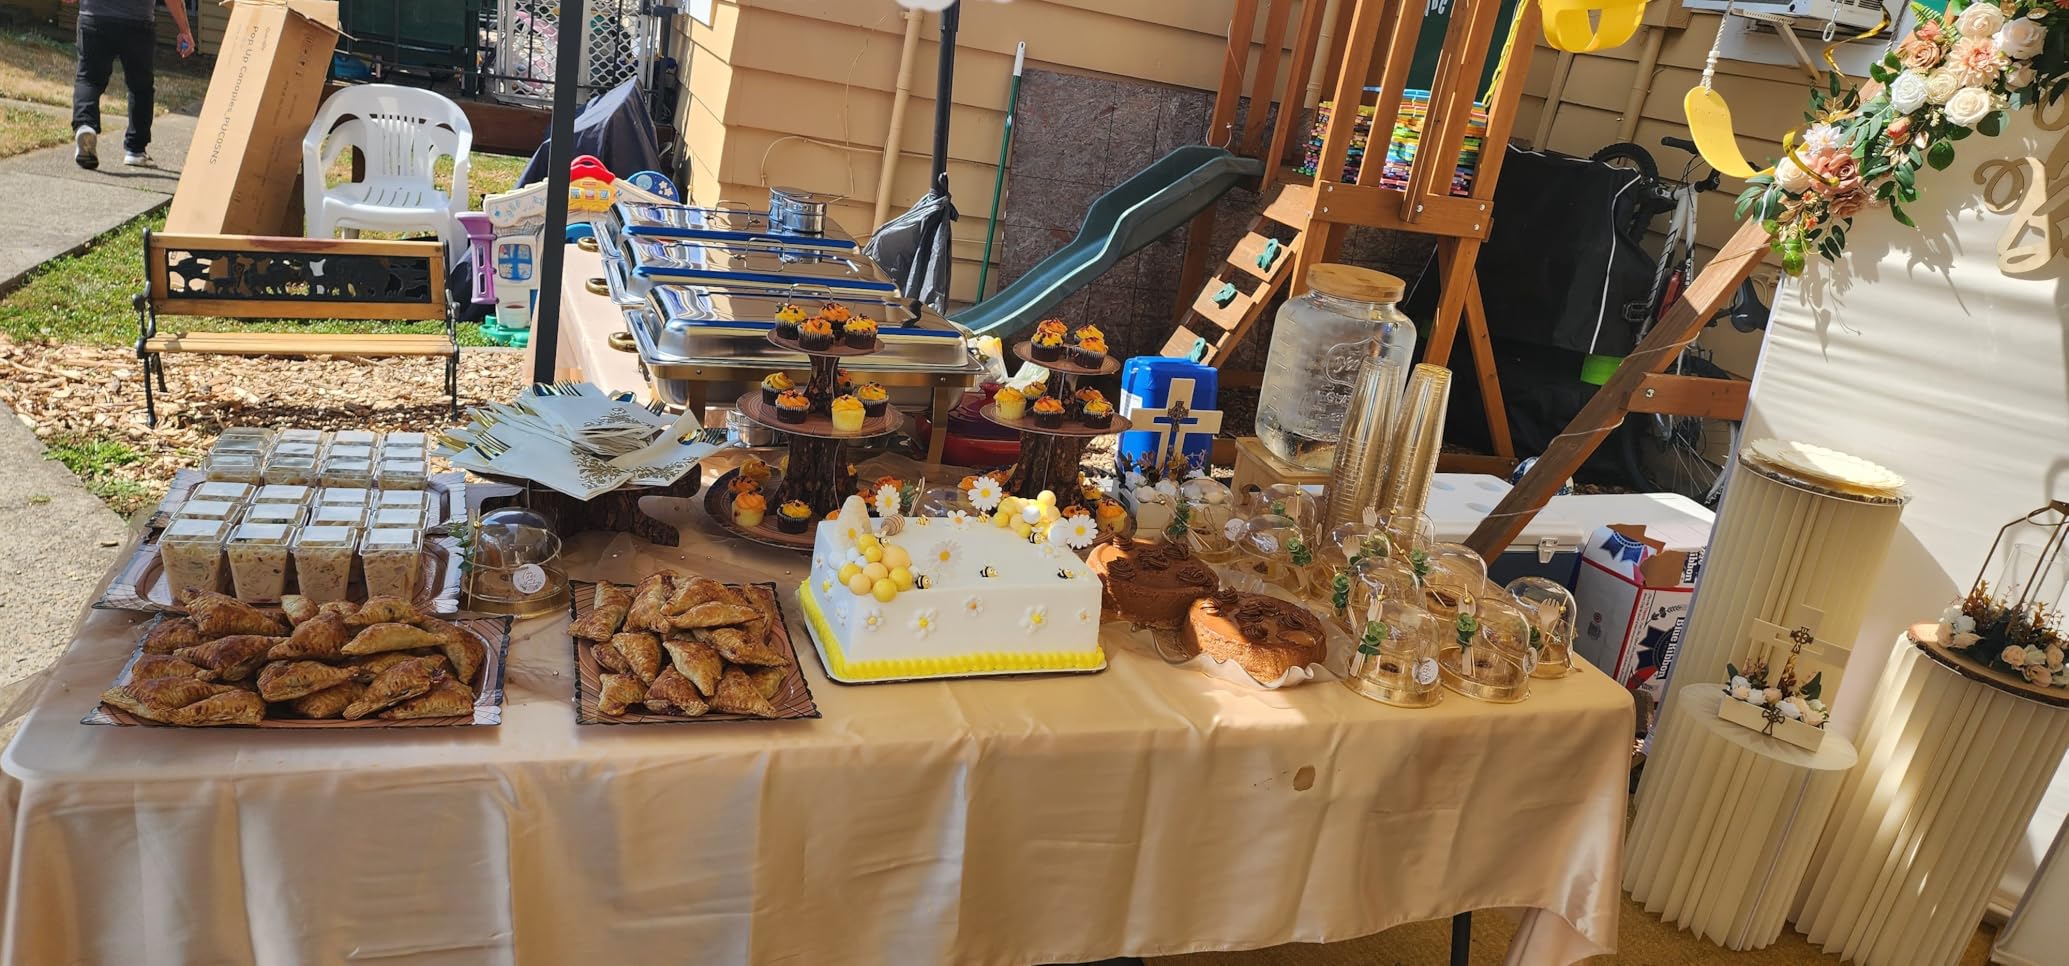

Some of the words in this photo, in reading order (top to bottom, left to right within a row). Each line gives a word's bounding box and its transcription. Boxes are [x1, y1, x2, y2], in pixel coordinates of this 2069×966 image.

[247, 26, 259, 45] Pop
[242, 48, 252, 63] Up
[1685, 551, 1698, 582] ibbon
[1657, 642, 1677, 678] Ribbon
